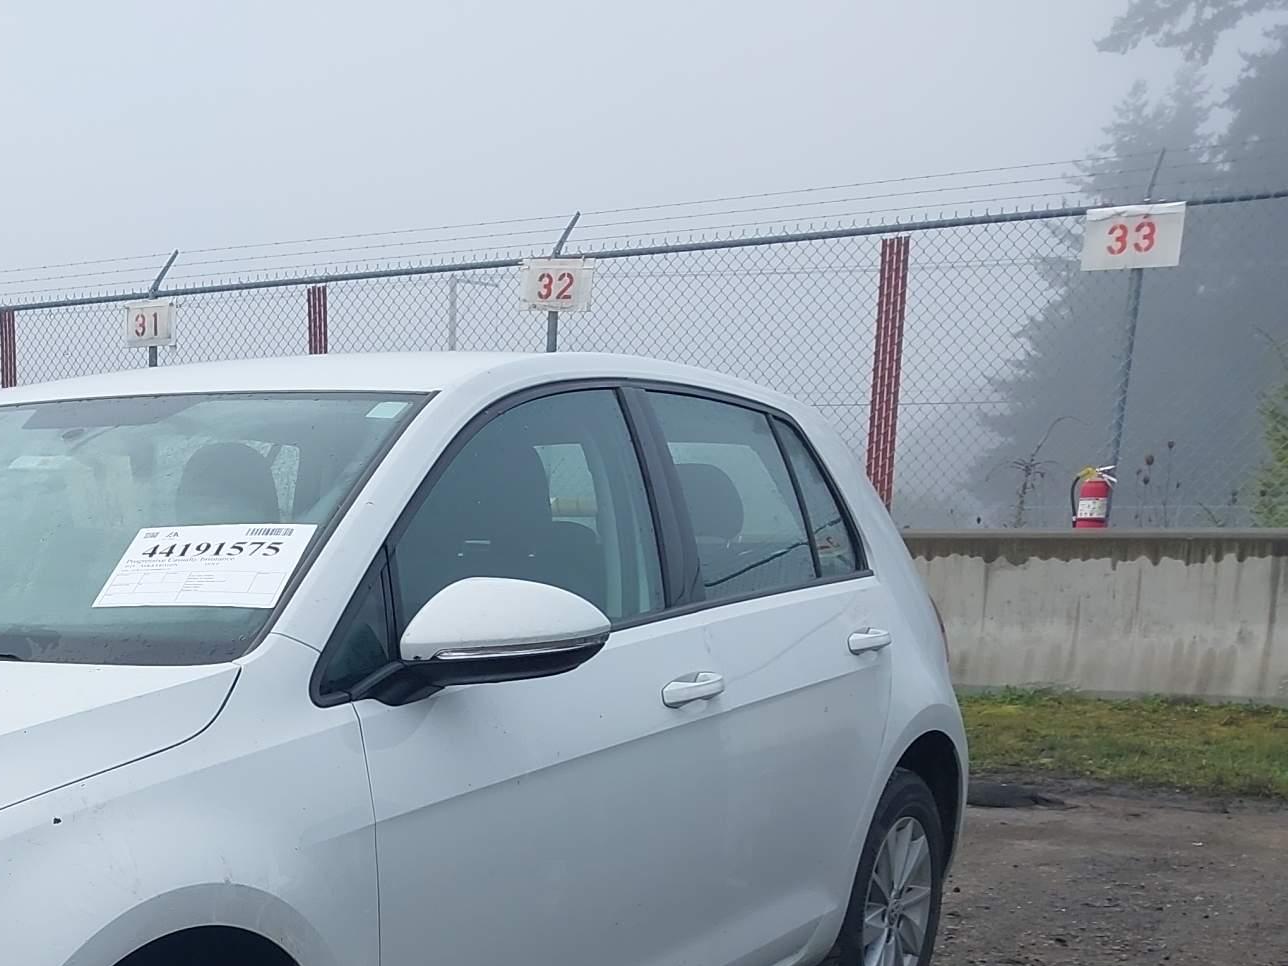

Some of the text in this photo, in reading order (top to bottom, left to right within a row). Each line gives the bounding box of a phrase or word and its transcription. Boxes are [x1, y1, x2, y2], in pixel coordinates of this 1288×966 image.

[1106, 221, 1156, 255] 33
[537, 272, 574, 300] 32
[135, 312, 158, 337] 31
[142, 541, 284, 558] 44191575
